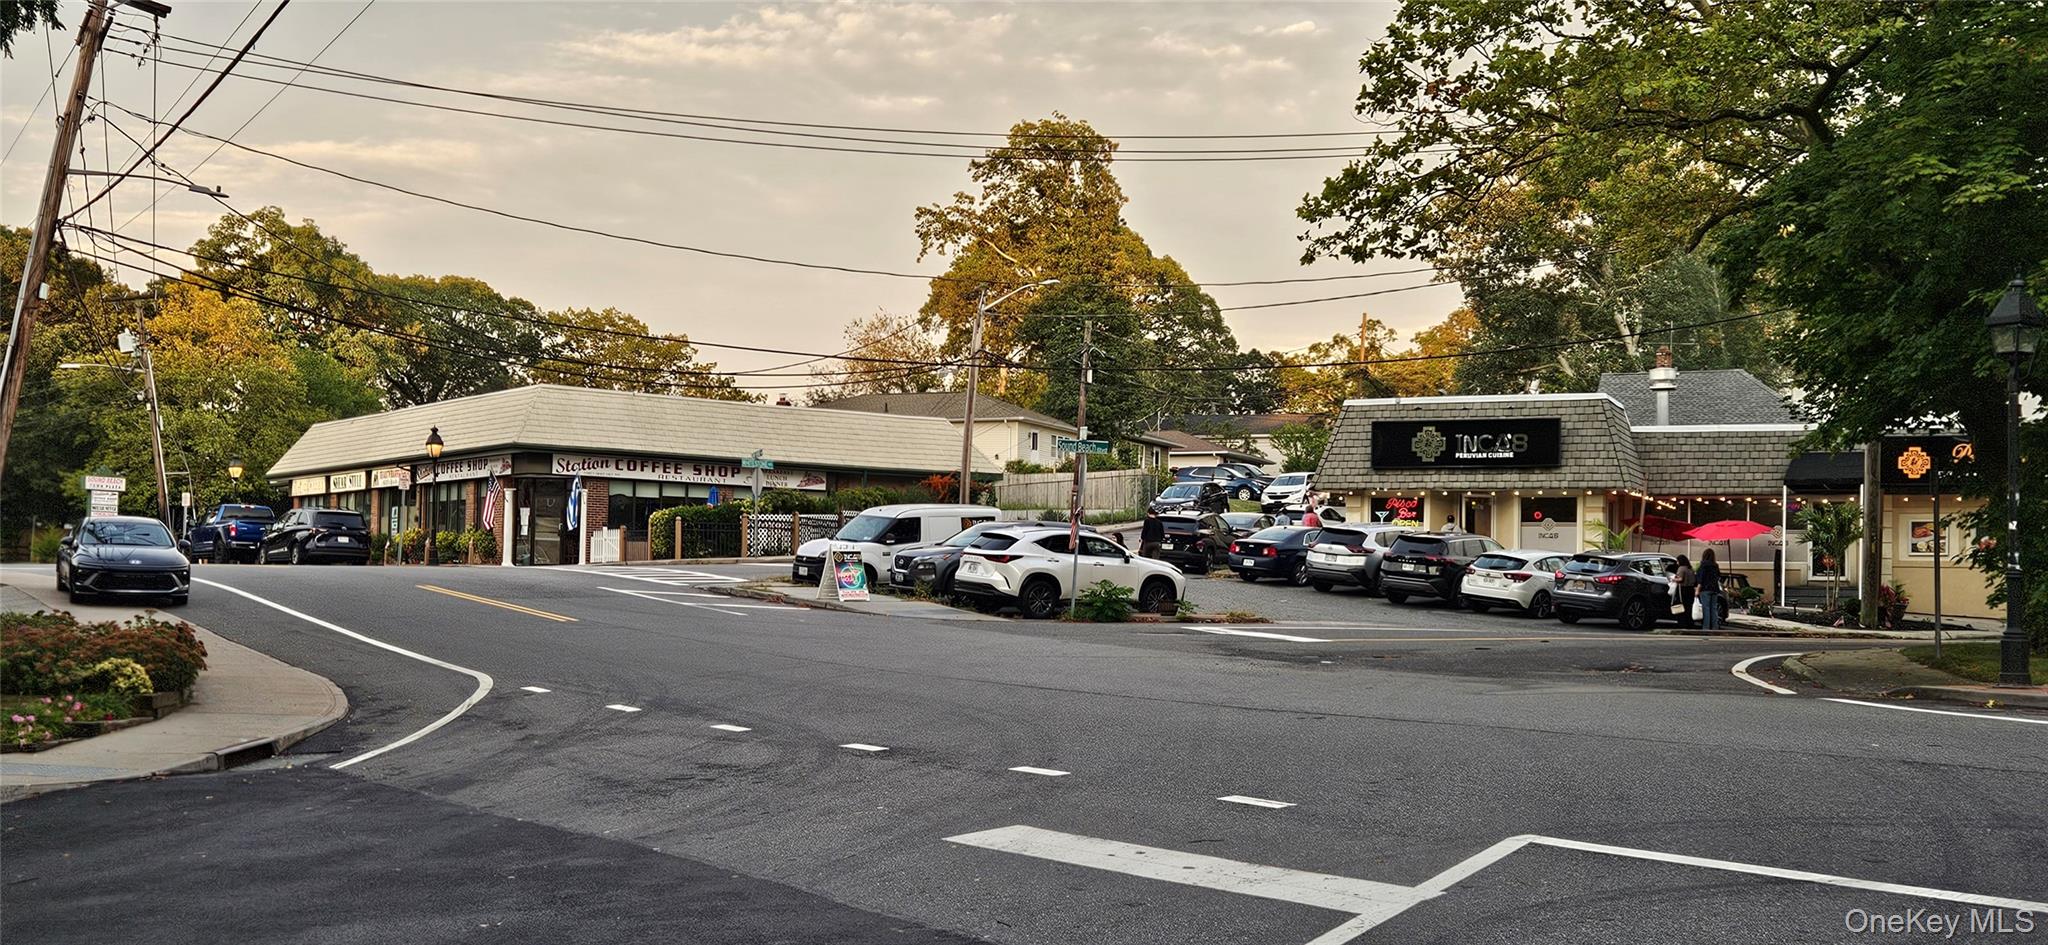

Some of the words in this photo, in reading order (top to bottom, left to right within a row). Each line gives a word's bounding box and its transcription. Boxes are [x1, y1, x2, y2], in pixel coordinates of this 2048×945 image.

[1058, 441, 1077, 452] Sound
[1078, 442, 1097, 452] Beach
[436, 461, 463, 475] COFFEE
[467, 458, 489, 472] SHOP
[555, 457, 611, 473] Station
[615, 459, 682, 475] COFFEE
[692, 464, 740, 478] SHOP
[657, 474, 727, 484] RESTAURANT
[1397, 508, 1417, 519] Bar
[1391, 518, 1419, 528] OPEN
